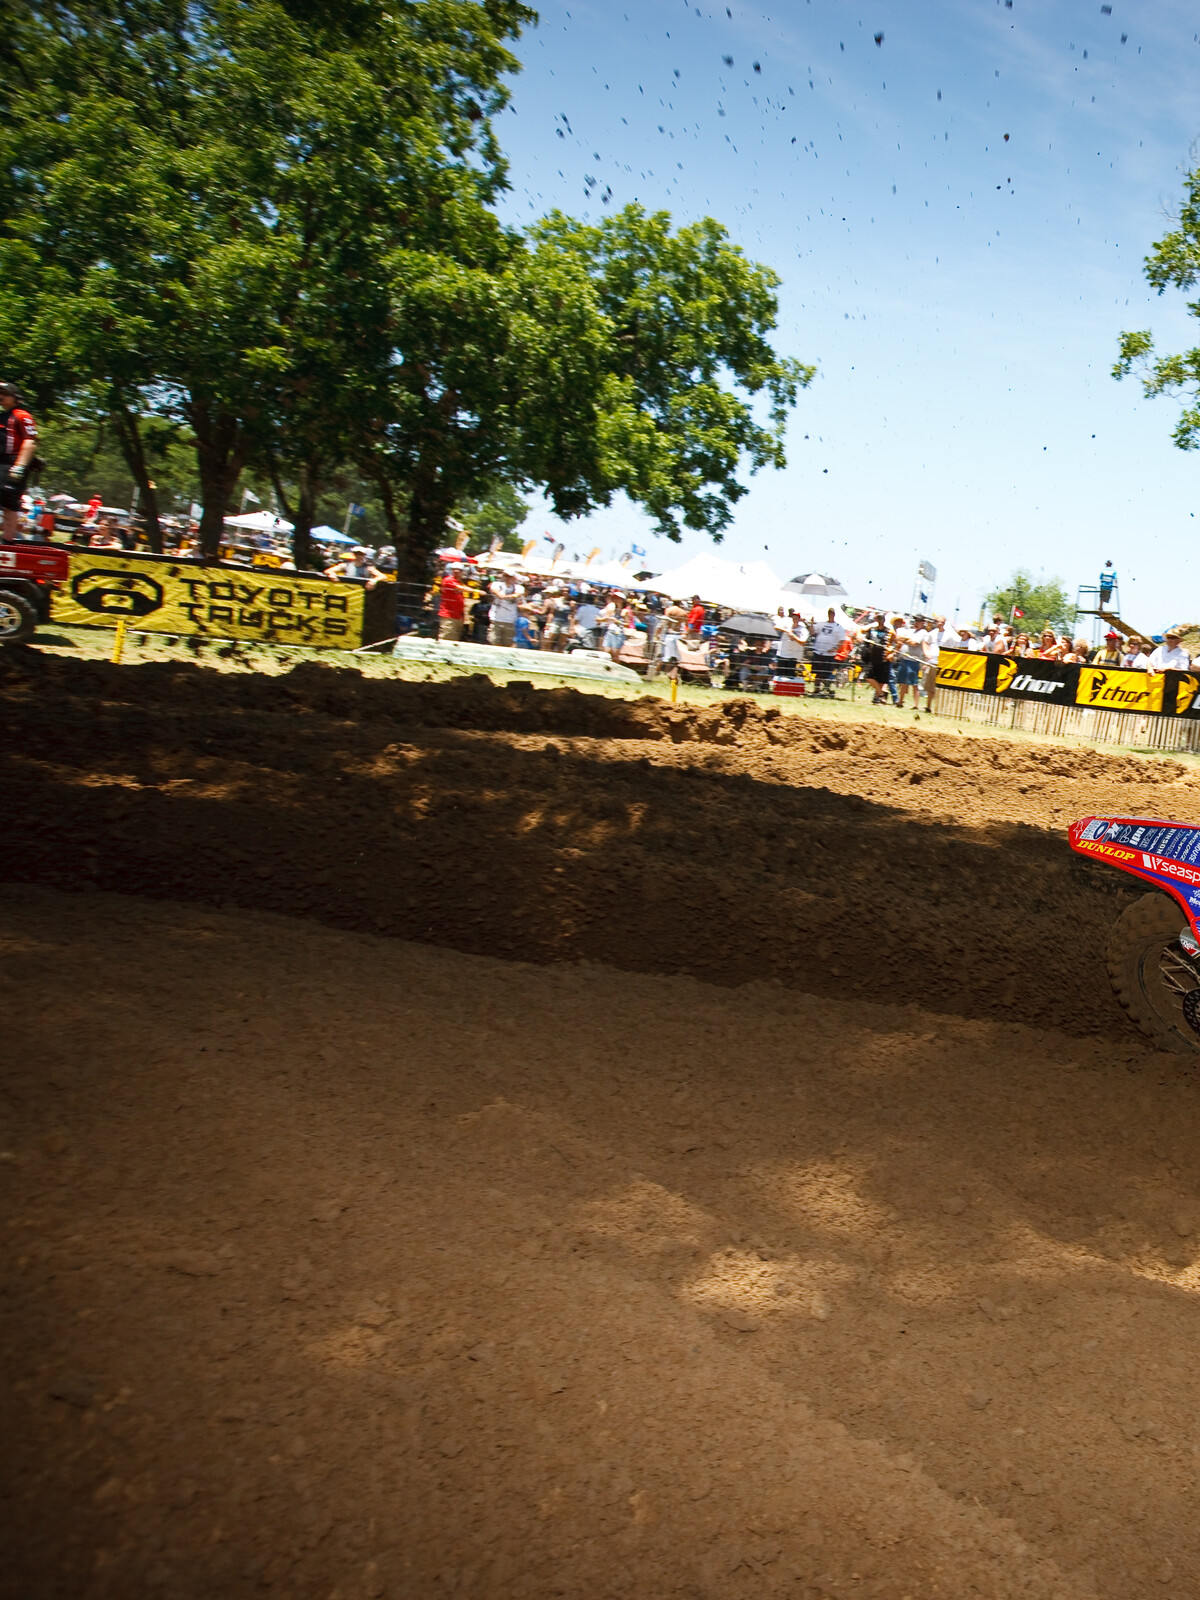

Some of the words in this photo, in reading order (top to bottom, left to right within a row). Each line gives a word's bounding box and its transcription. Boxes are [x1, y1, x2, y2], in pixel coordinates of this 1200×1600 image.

[179, 577, 348, 613] TOYOTA
[179, 601, 347, 636] TRUCKS
[1010, 674, 1065, 695] thor
[1102, 686, 1150, 703] thor
[1076, 839, 1136, 861] DUNLOP
